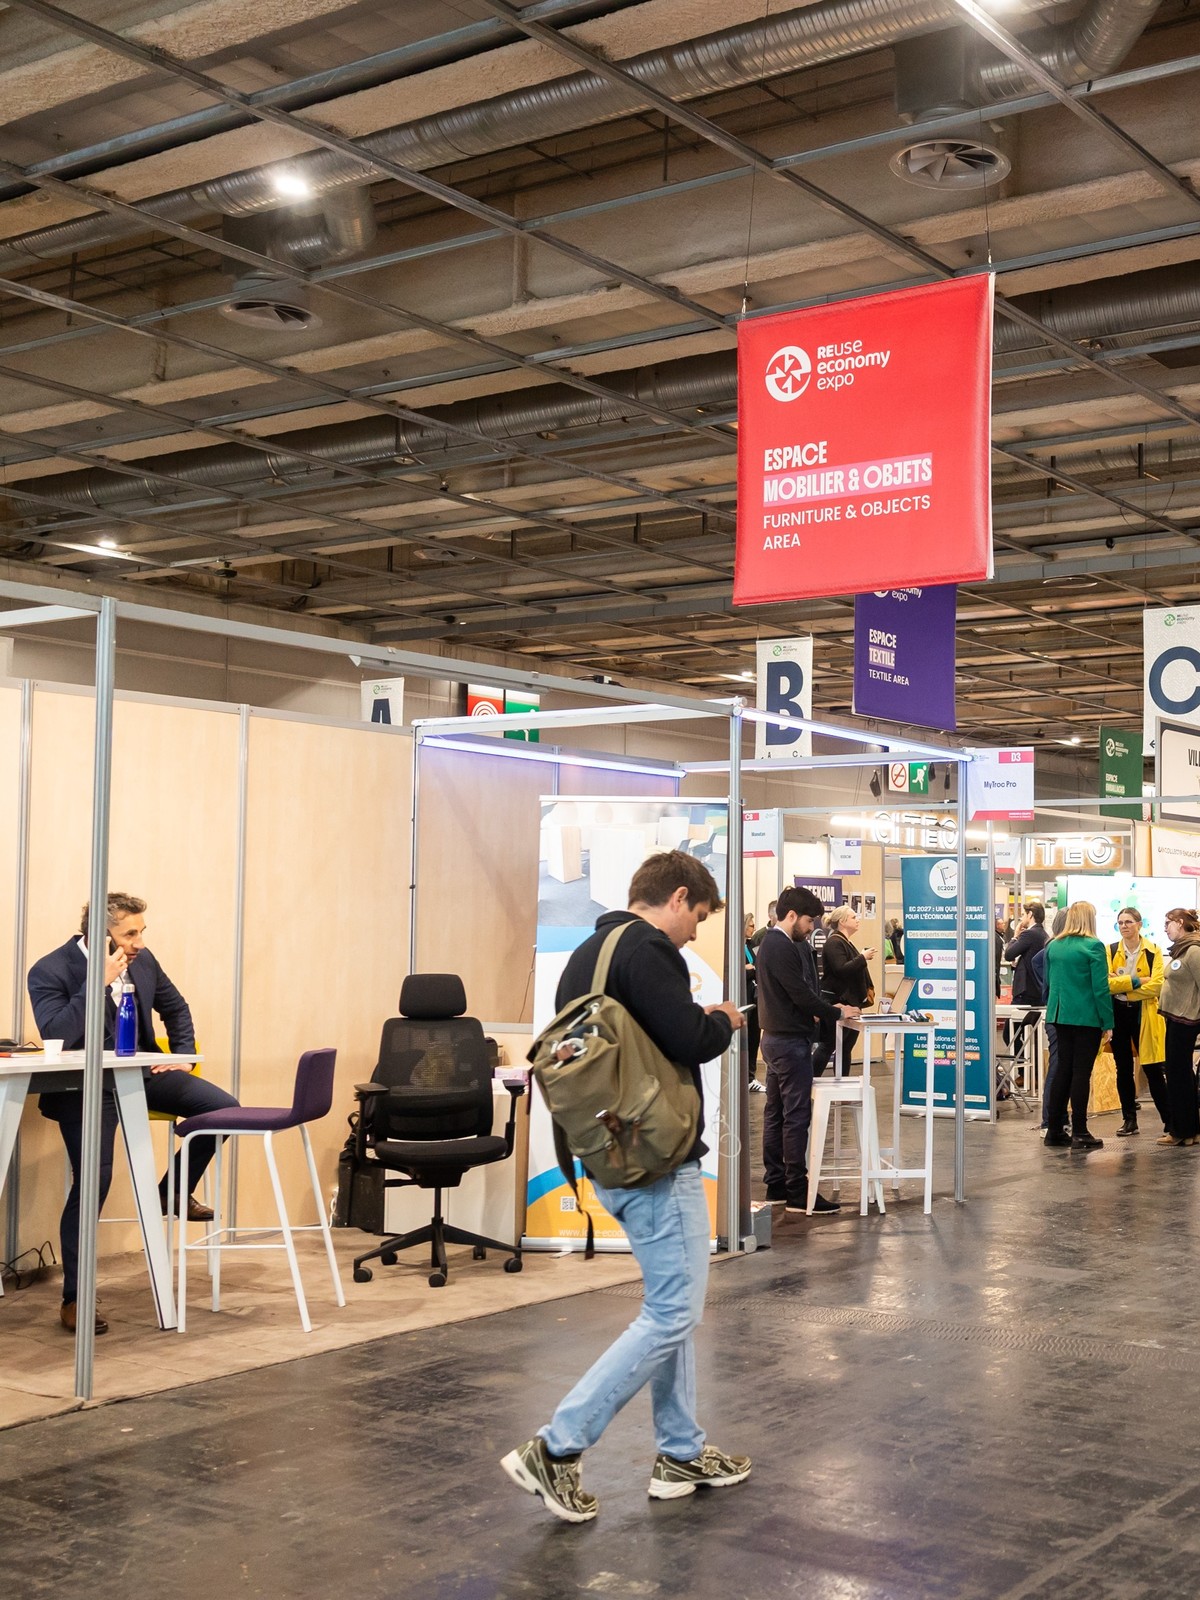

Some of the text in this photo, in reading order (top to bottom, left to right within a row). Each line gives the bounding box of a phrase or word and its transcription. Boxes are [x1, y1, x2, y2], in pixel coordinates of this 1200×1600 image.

[817, 340, 863, 359] REuse
[816, 350, 891, 375] economy
[816, 373, 855, 392] expo
[764, 441, 828, 471] ESPACE
[763, 457, 933, 503] MOBILIER & OBJETS
[763, 495, 931, 529] FURNITURE & OBJECTS
[763, 533, 801, 550] AREA
[892, 590, 908, 602] expo
[869, 628, 897, 648] ESPACE
[869, 647, 895, 667] TEXTILE
[869, 669, 910, 686] TEXTILE AREA
[765, 661, 804, 746] B
[1011, 752, 1021, 762] D3
